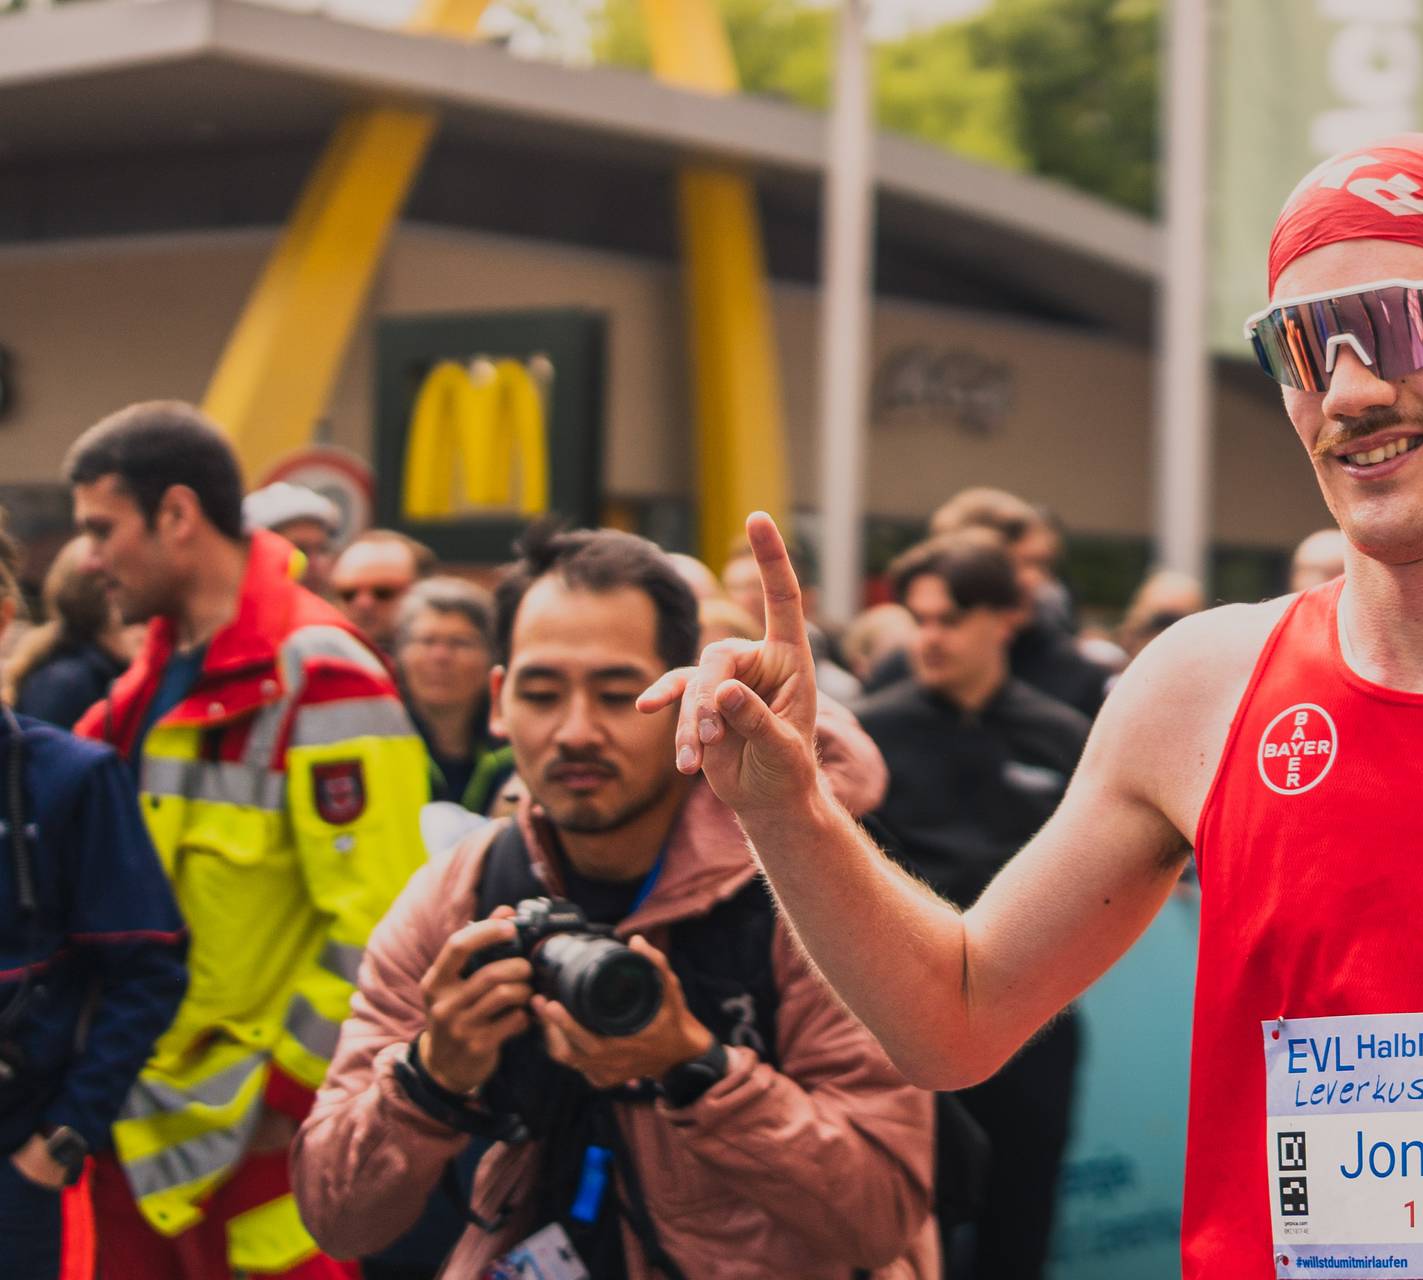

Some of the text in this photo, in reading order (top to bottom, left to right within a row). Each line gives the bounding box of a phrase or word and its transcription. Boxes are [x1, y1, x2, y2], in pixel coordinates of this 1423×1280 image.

[1263, 740, 1331, 758] BAYER
[1286, 711, 1309, 787] BAYER
[1287, 1036, 1355, 1073] EVL
[1404, 1200, 1415, 1228] 1
[1296, 1255, 1408, 1269] #willstdumitmirlaufen
